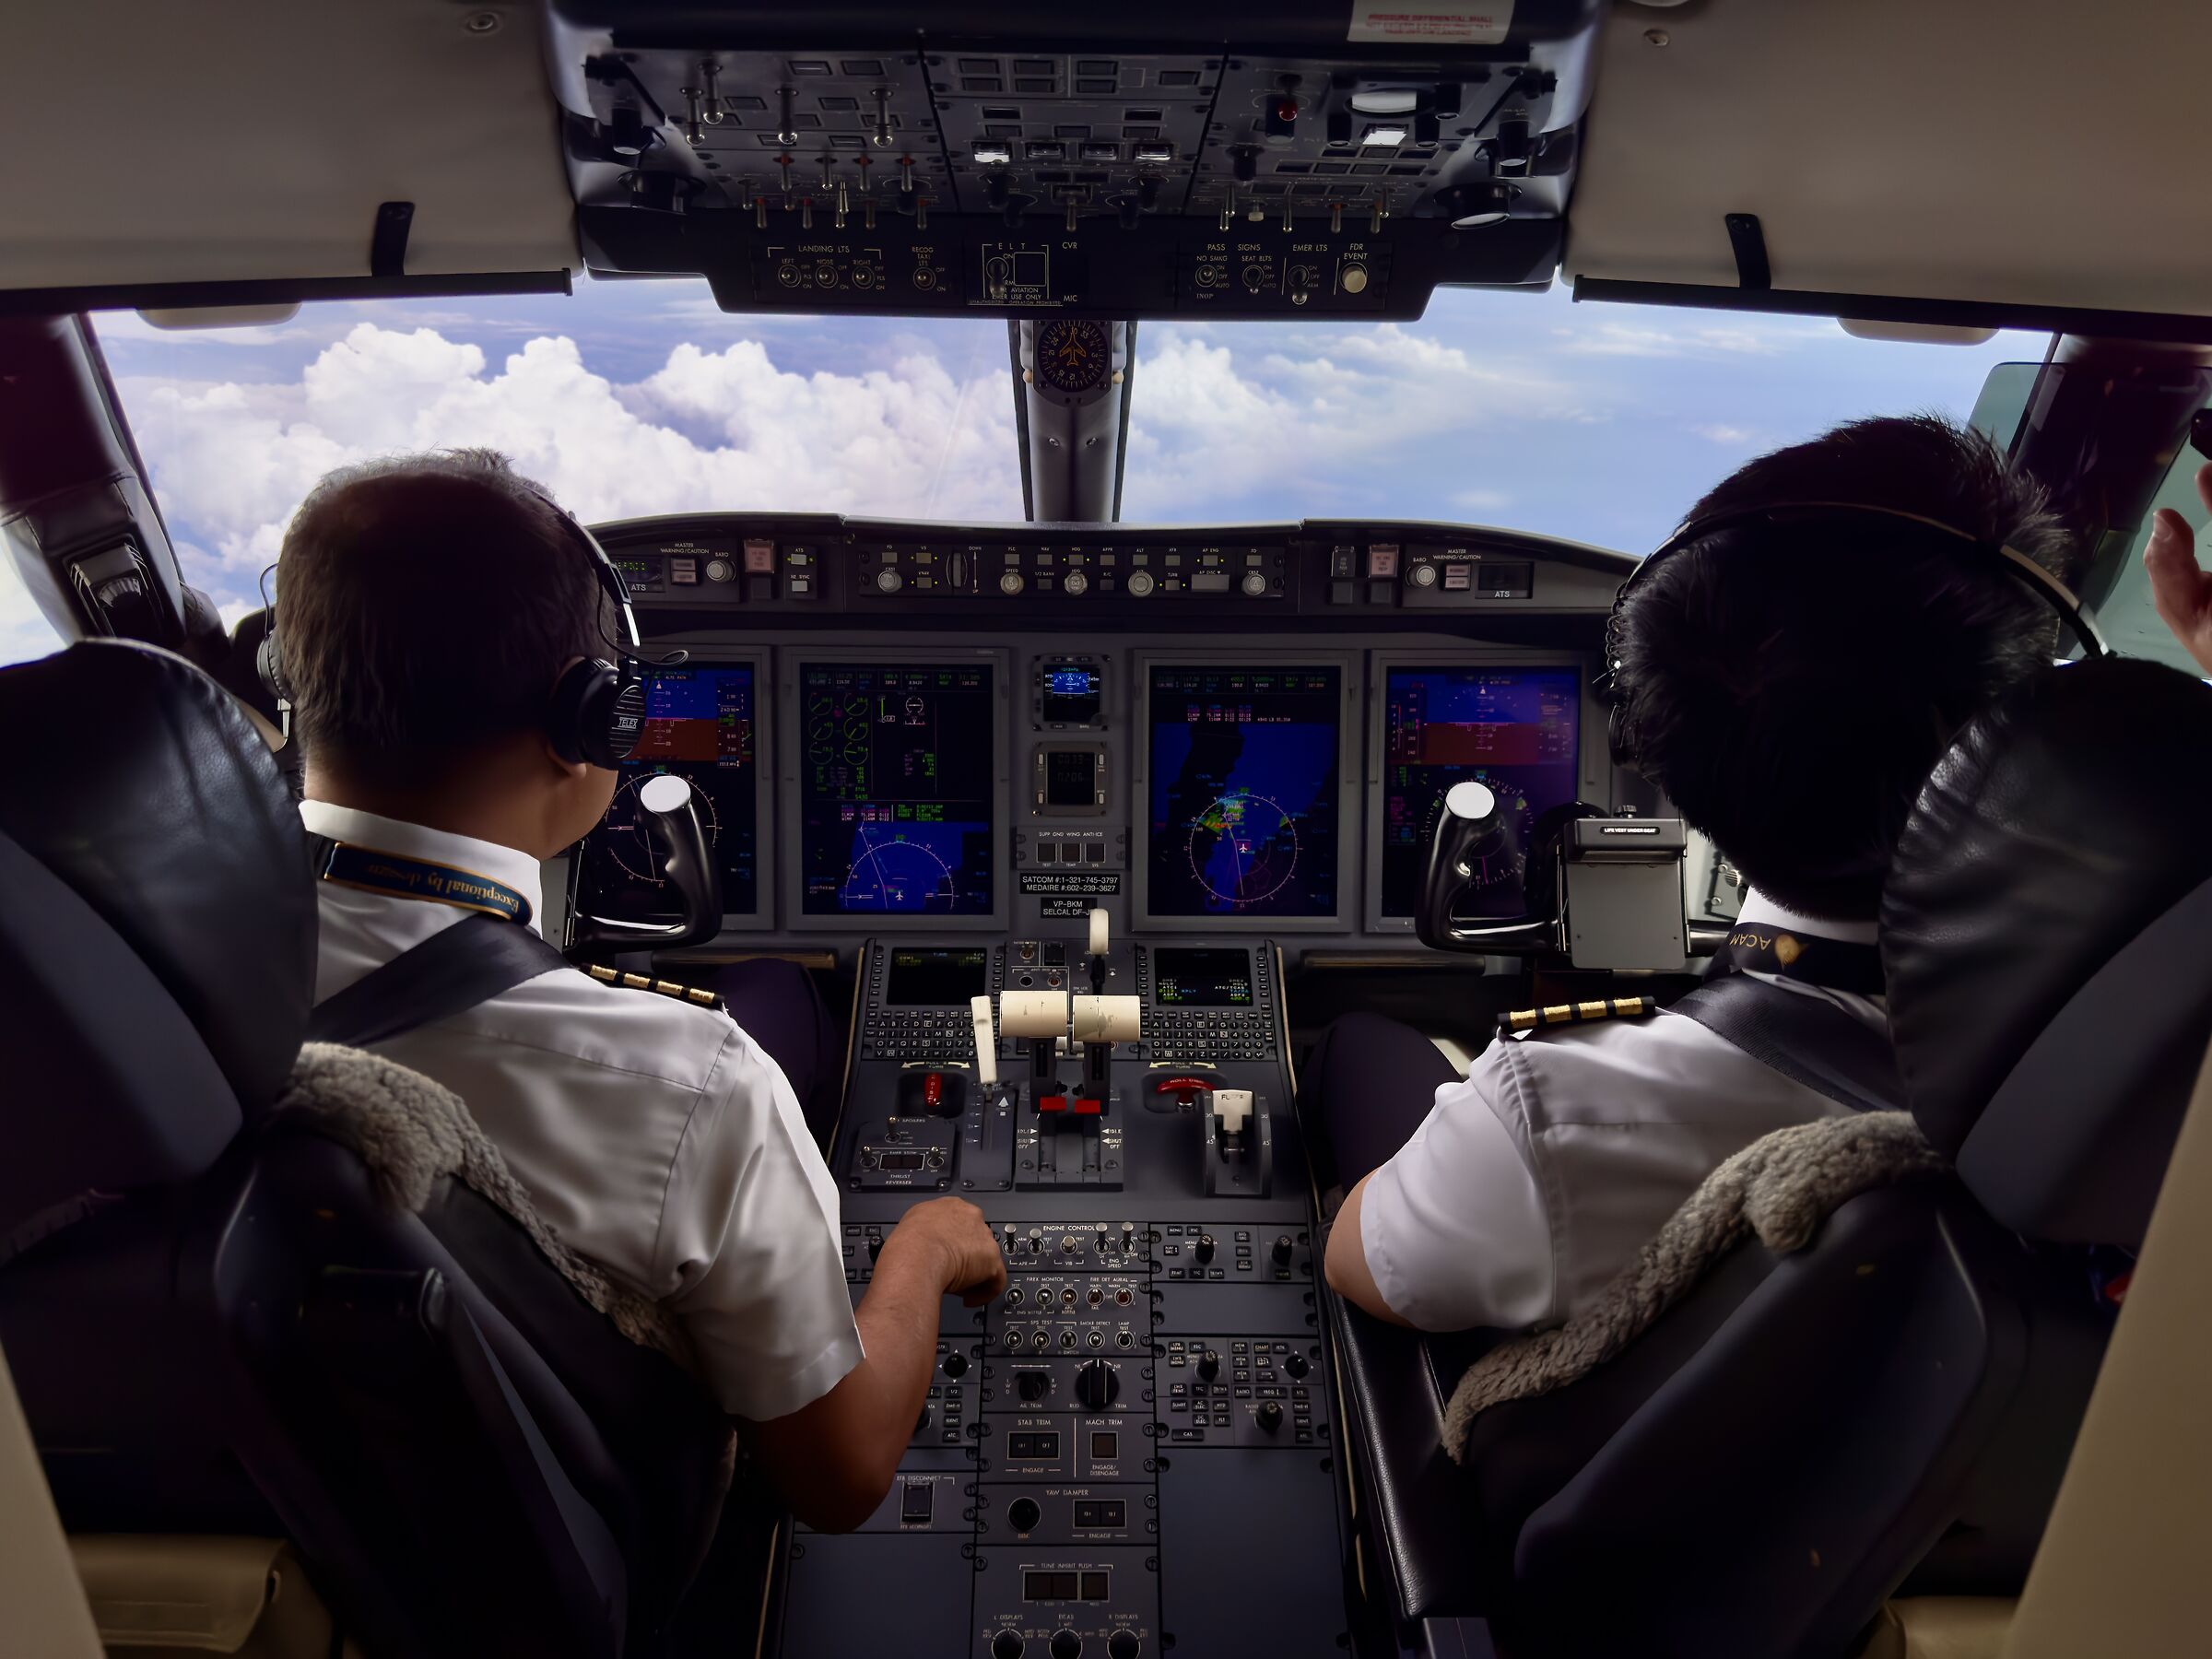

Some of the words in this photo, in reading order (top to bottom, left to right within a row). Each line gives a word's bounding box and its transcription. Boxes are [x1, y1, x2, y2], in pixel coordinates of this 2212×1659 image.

[837, 245, 850, 253] LTS
[618, 719, 638, 727] TELEX
[428, 872, 443, 892] by
[445, 876, 519, 913] Exceptional
